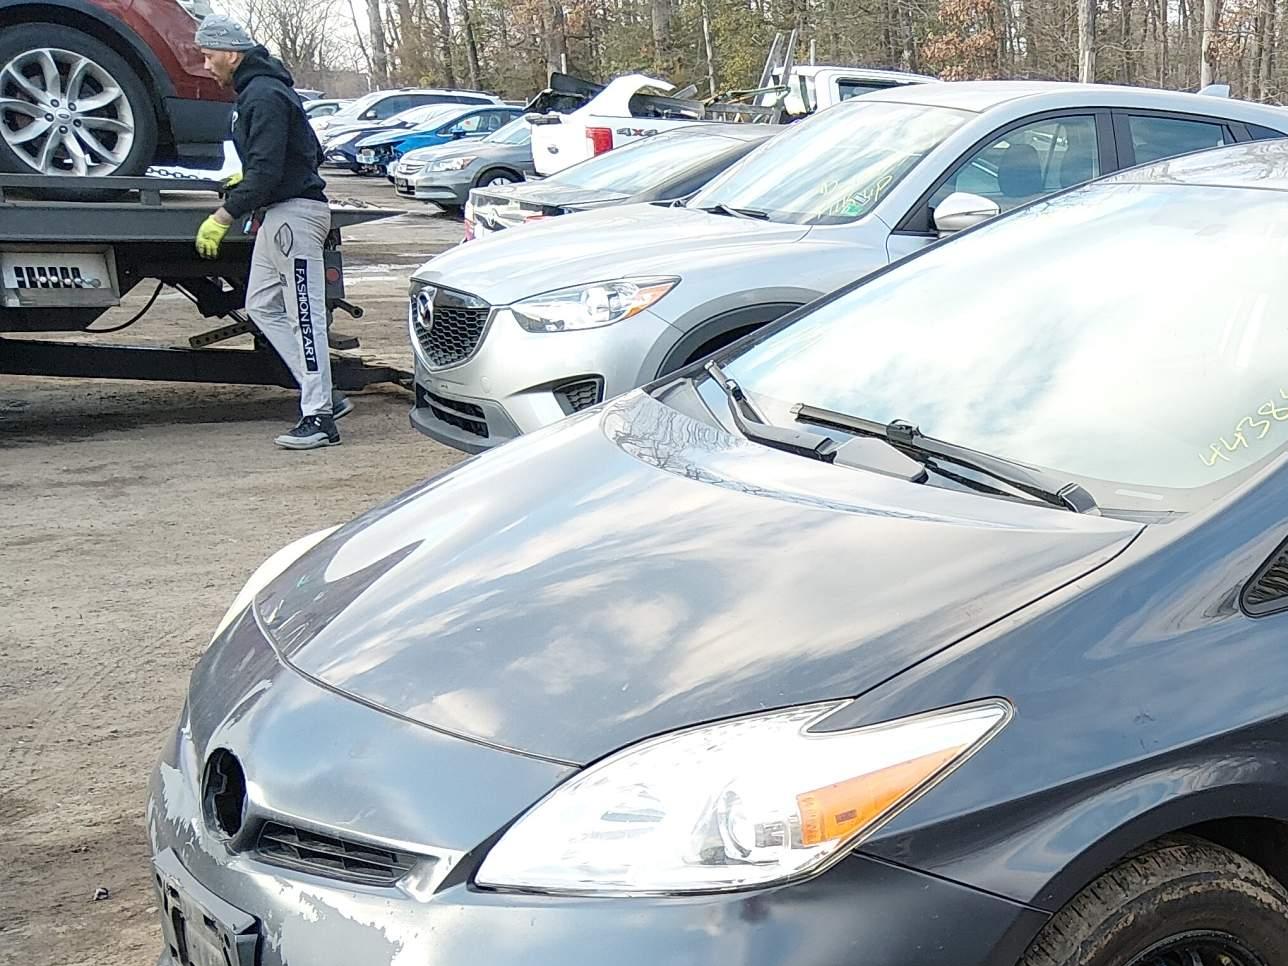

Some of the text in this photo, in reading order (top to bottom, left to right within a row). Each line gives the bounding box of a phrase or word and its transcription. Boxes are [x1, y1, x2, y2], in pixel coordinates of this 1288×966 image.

[296, 268, 316, 363] FASHION IS ART
